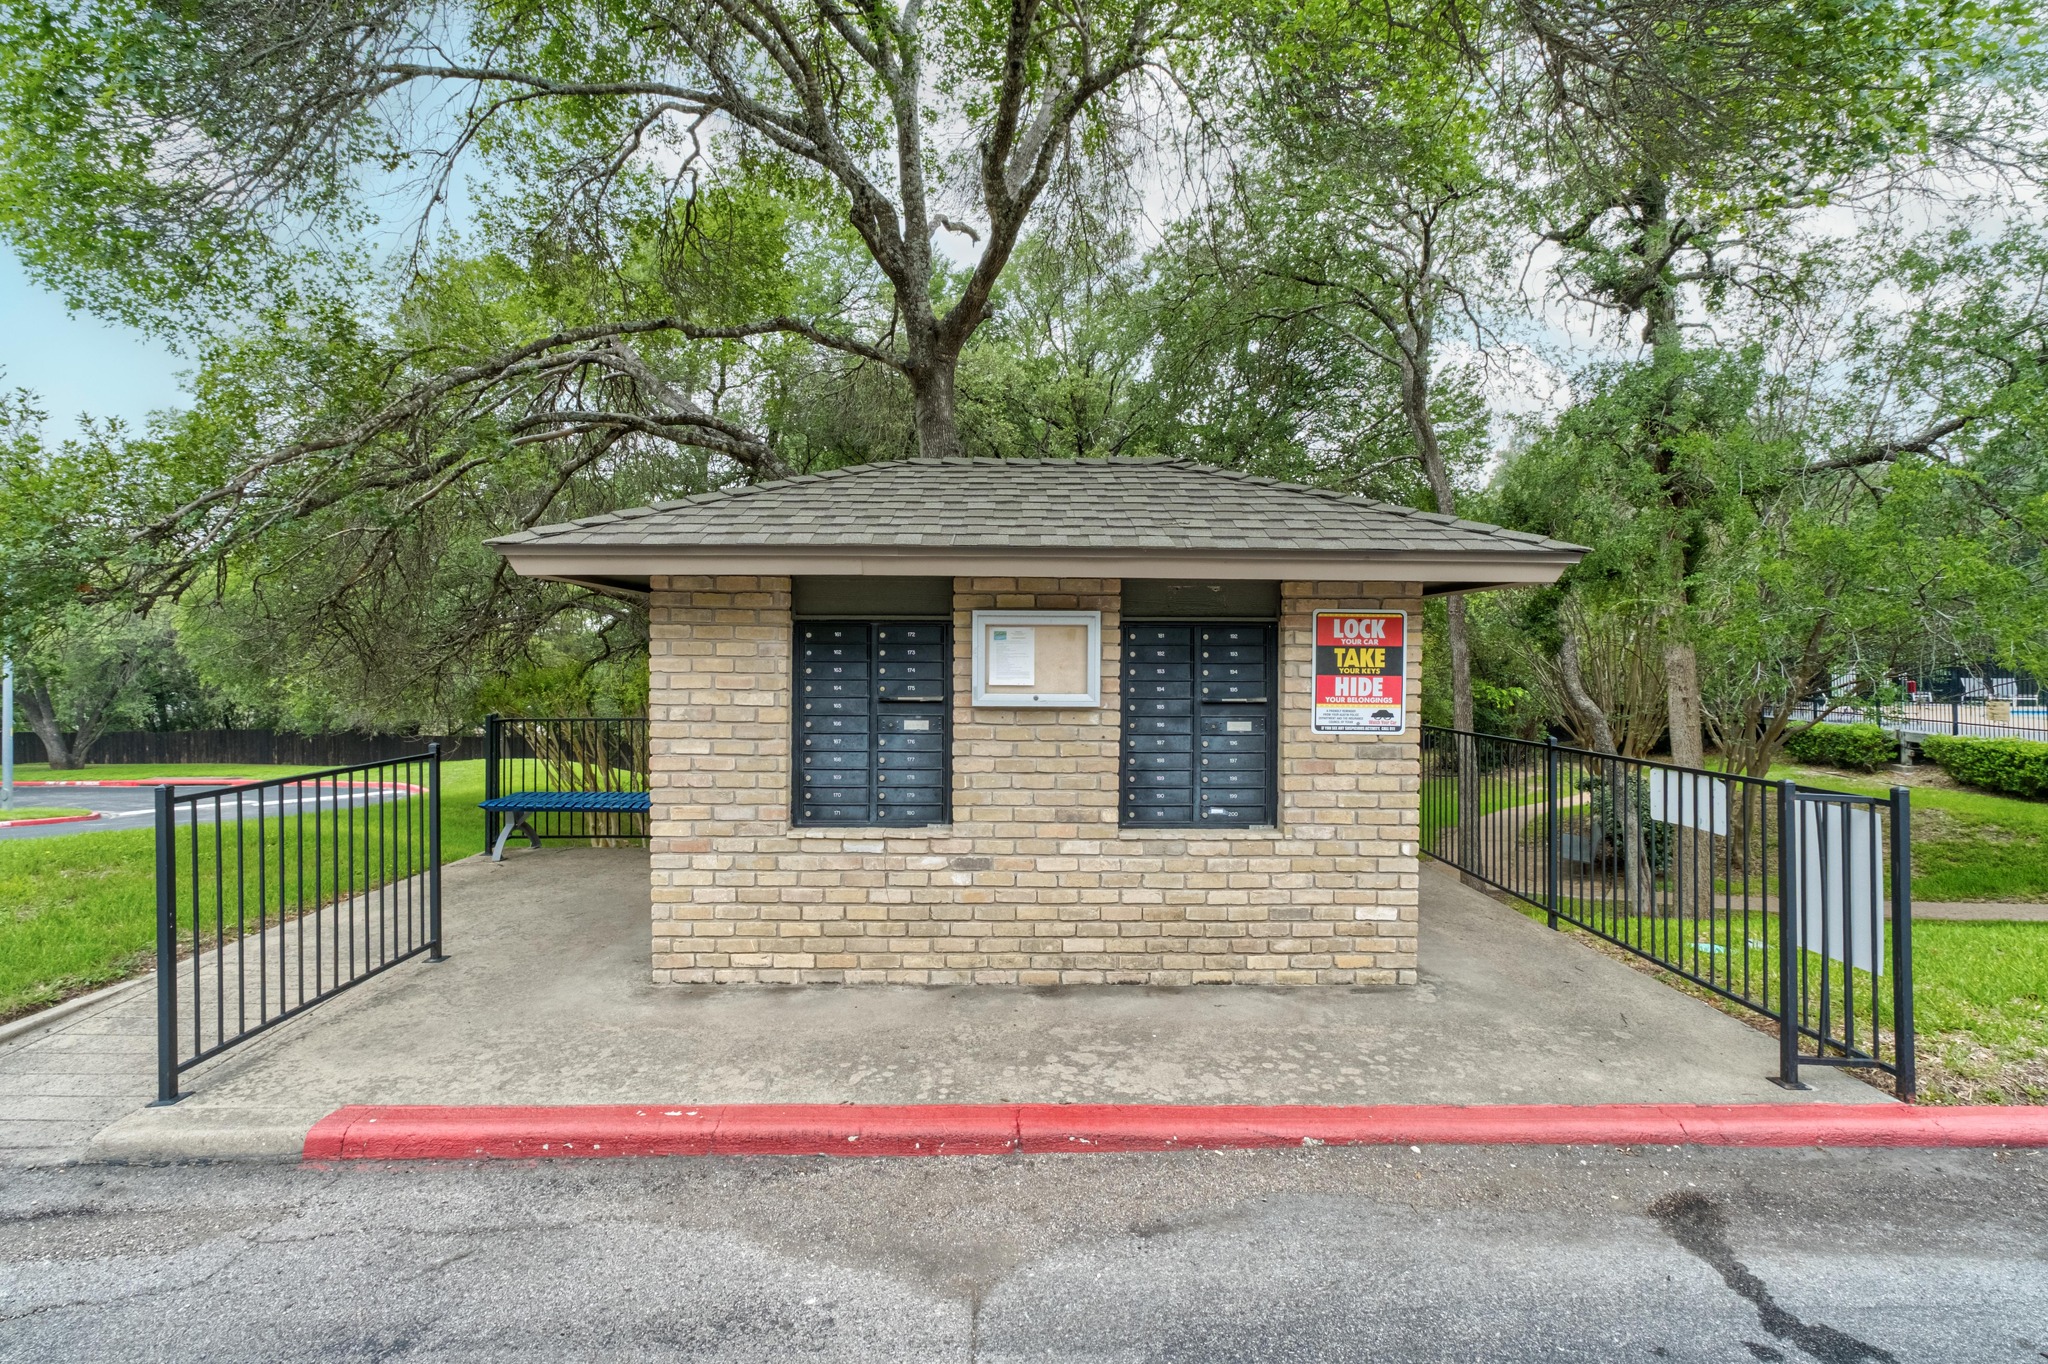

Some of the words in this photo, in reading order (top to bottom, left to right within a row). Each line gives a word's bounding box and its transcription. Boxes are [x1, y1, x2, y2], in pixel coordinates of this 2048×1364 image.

[1334, 619, 1385, 638] LOCK
[1334, 648, 1385, 668] TAKE
[1339, 667, 1361, 675] YOUR
[1362, 667, 1381, 675] KEYS
[1335, 677, 1383, 697] HIDE
